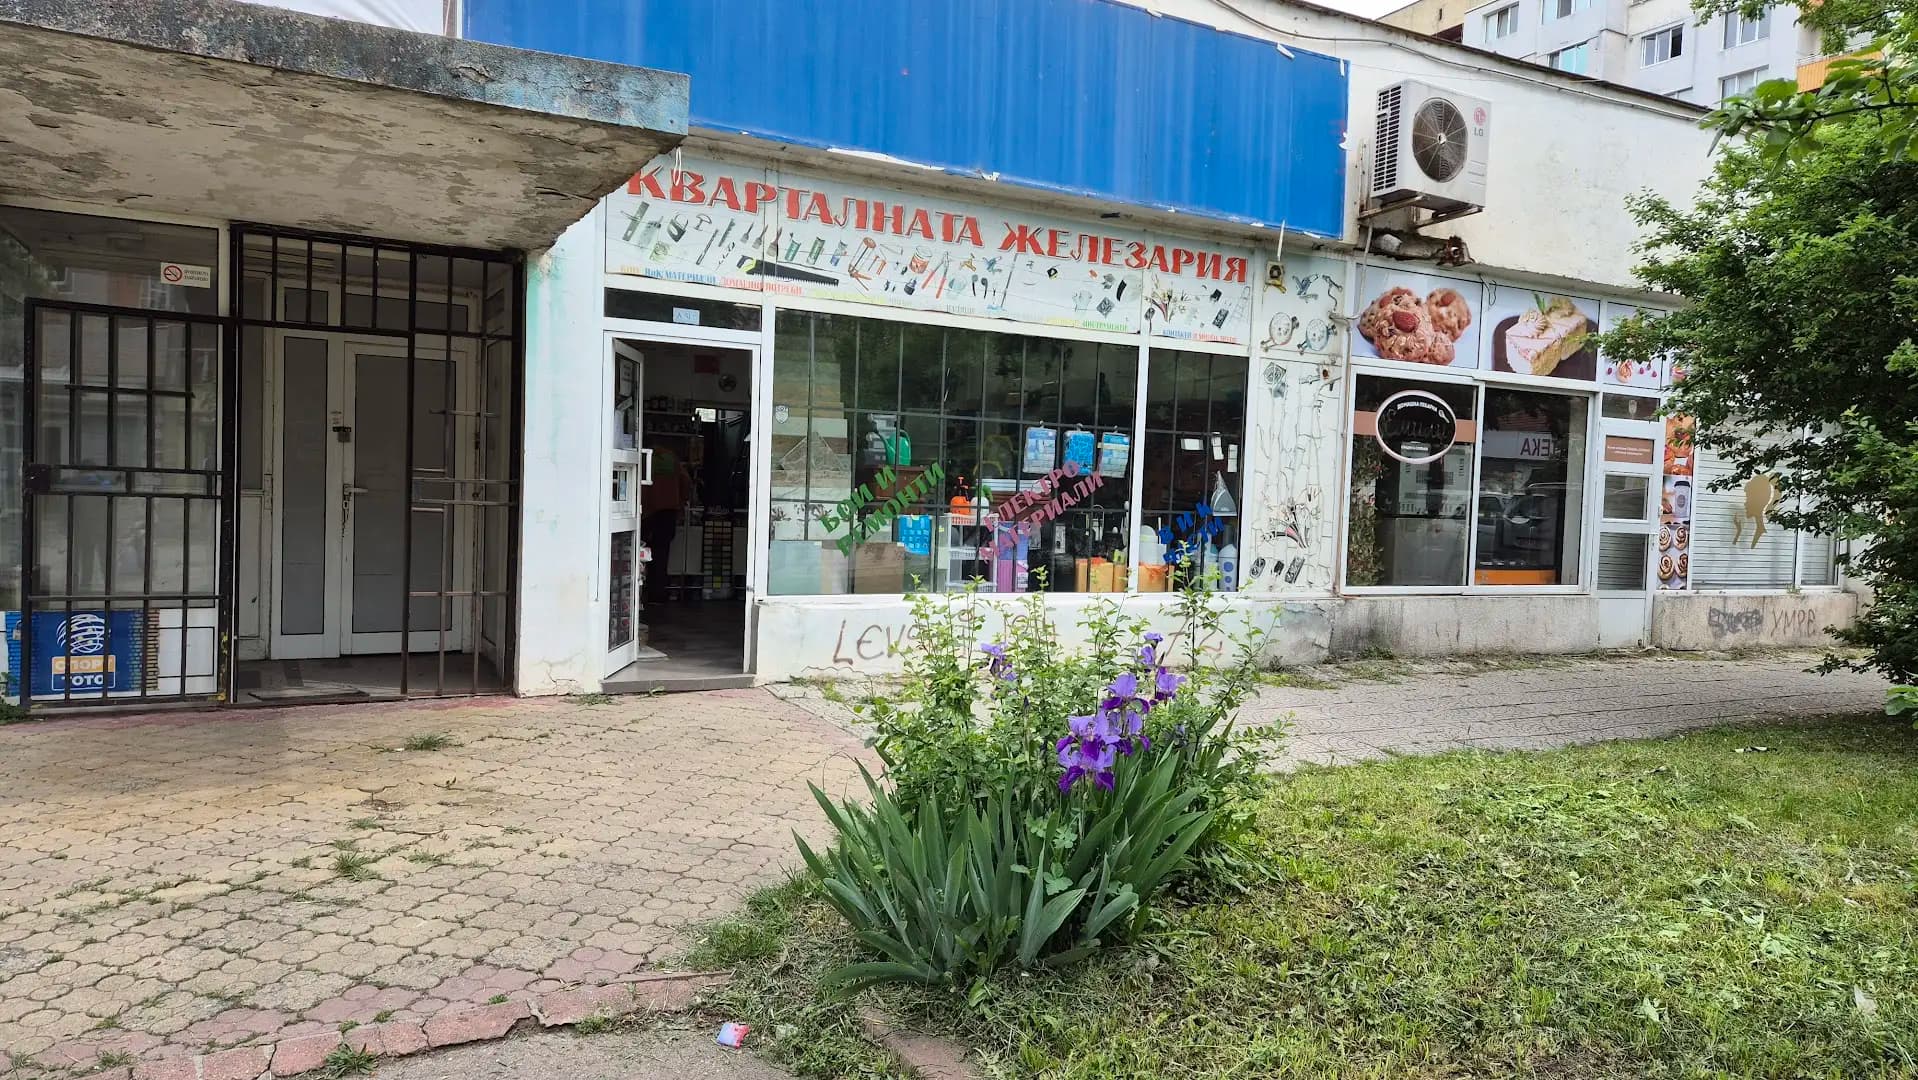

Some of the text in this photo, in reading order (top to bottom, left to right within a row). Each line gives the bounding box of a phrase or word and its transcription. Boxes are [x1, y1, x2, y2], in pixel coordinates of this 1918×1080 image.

[1473, 127, 1484, 137] LG
[627, 164, 1249, 284] КВАРТАЛНАТА ЖЕЛЕЗАРИЯ
[821, 465, 897, 533] БОИ И
[836, 462, 945, 557] РЕМОНТИ
[55, 658, 112, 672] СПОР
[61, 674, 105, 686] ОТО
